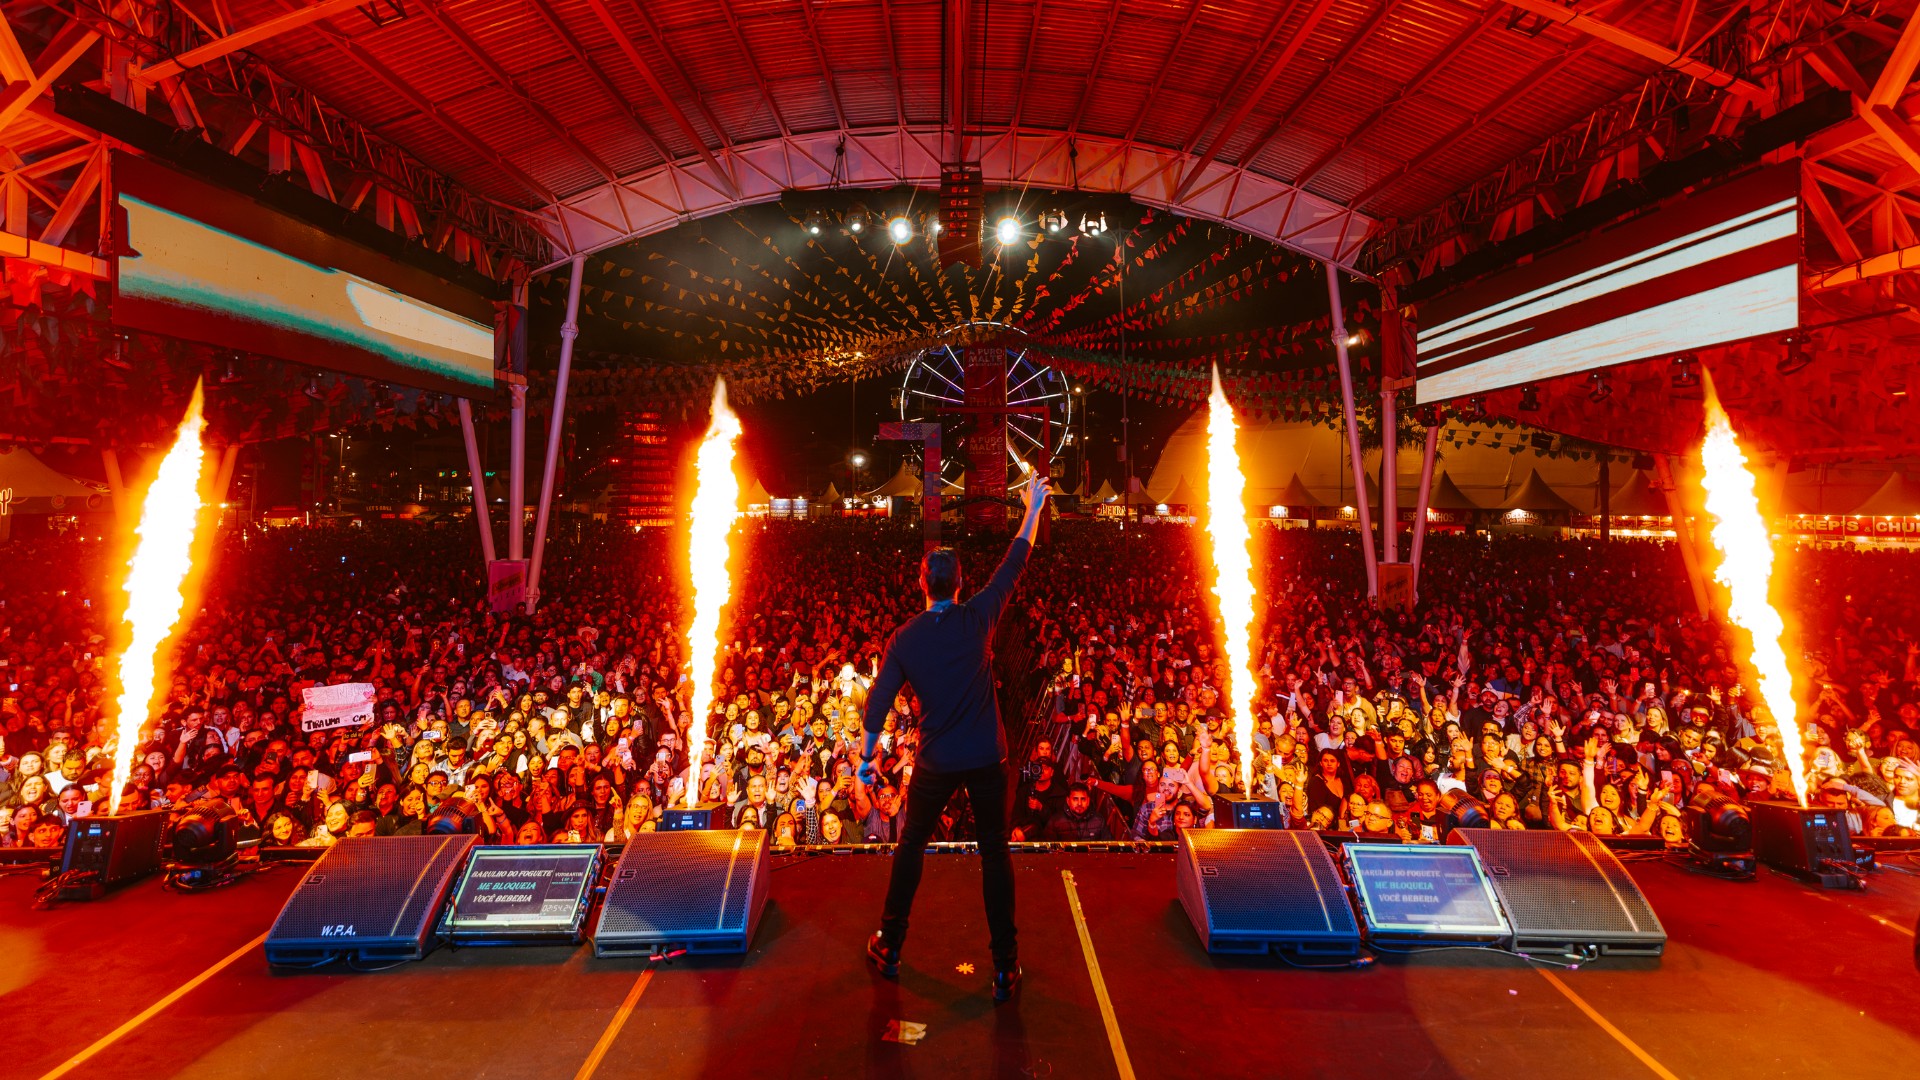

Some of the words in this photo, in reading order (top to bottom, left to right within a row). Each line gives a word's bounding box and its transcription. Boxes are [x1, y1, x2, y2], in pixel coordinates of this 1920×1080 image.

[968, 355, 1003, 363] MALTE
[969, 443, 1003, 451] MALTE
[1269, 505, 1289, 518] BAR
[1787, 519, 1859, 532] KREP'S
[304, 719, 324, 730] TIRA
[325, 717, 340, 726] UMA
[471, 869, 506, 878] BARULHO
[506, 870, 518, 878] DO
[518, 869, 553, 878] FOGUETE
[1395, 869, 1406, 877] DO
[1406, 869, 1441, 878] FOGUETE
[476, 882, 491, 890] ME
[491, 881, 537, 891] BLOQUEIA
[1374, 881, 1388, 890] ME
[1389, 881, 1434, 891] BLOQUEIA
[472, 893, 495, 903] VOCÊ
[494, 894, 533, 903] BEBERIA
[1378, 893, 1400, 903] VOCÊ
[1401, 894, 1440, 903] BEBERIA
[320, 924, 356, 937] W.P.A.
